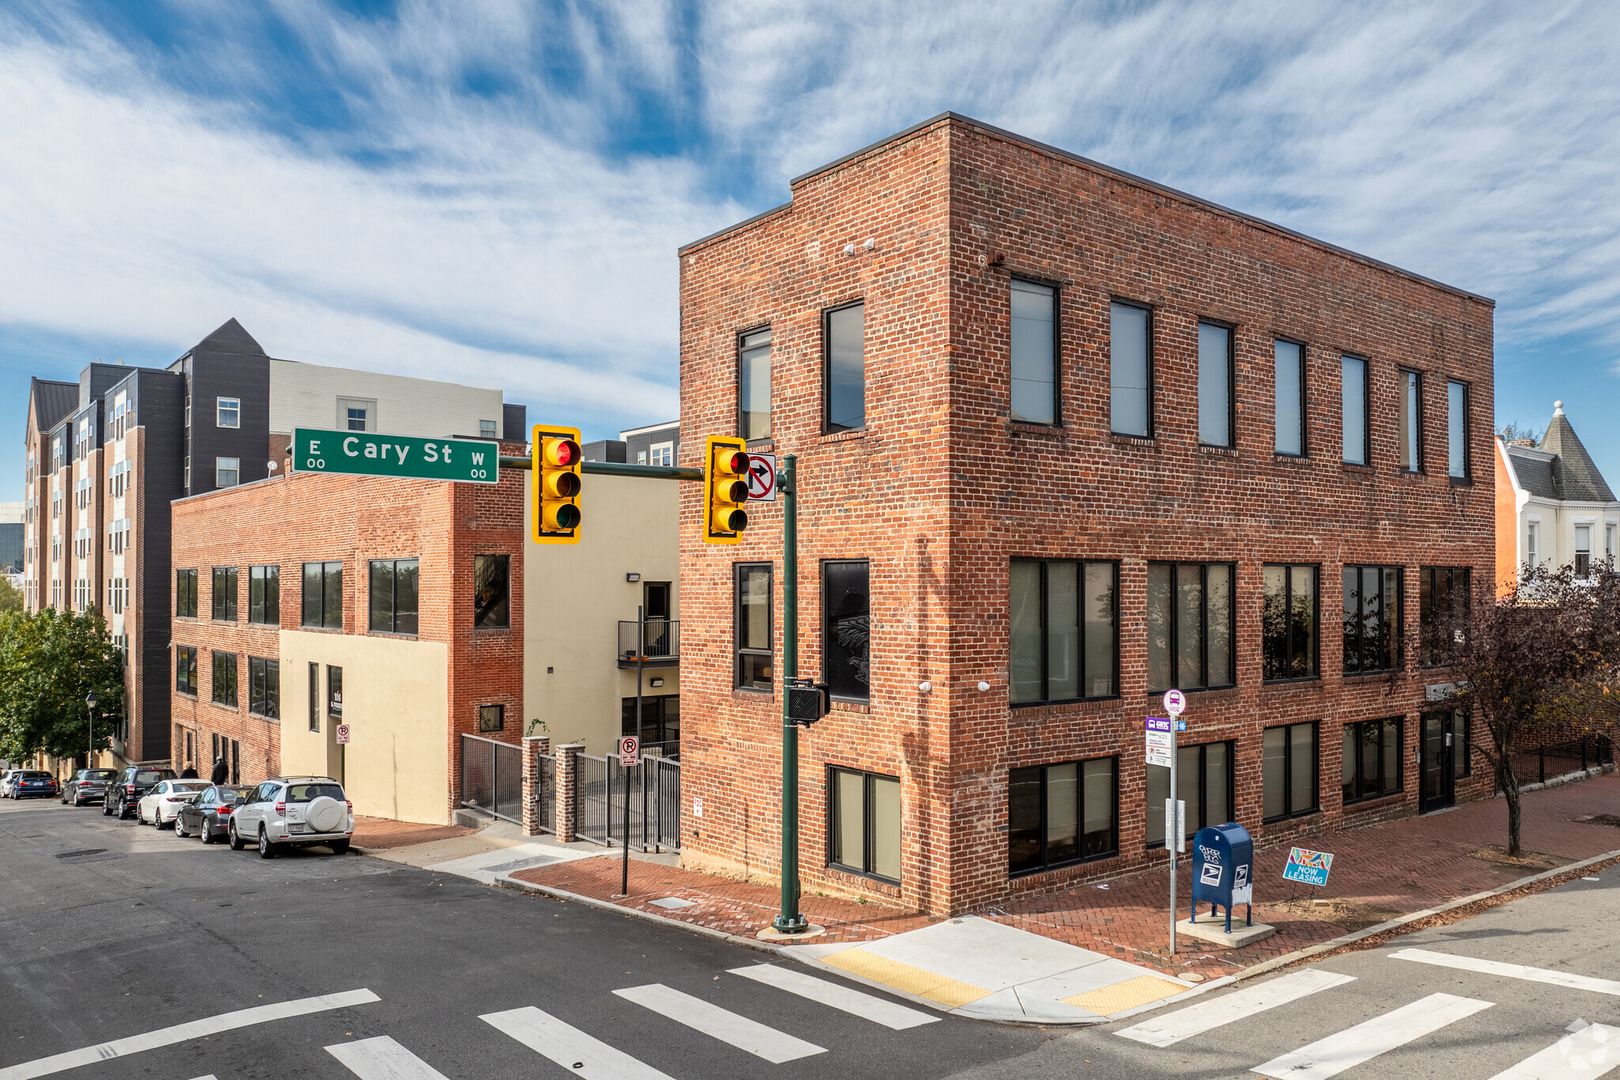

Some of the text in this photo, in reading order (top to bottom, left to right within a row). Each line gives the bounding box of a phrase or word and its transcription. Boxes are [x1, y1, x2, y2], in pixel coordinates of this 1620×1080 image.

[309, 440, 321, 455] E
[343, 437, 452, 465] Cary St
[306, 458, 326, 469] 00
[471, 452, 485, 466] W
[470, 469, 487, 479] 00
[1288, 870, 1323, 884] LEASING
[1297, 865, 1319, 876] NOW
